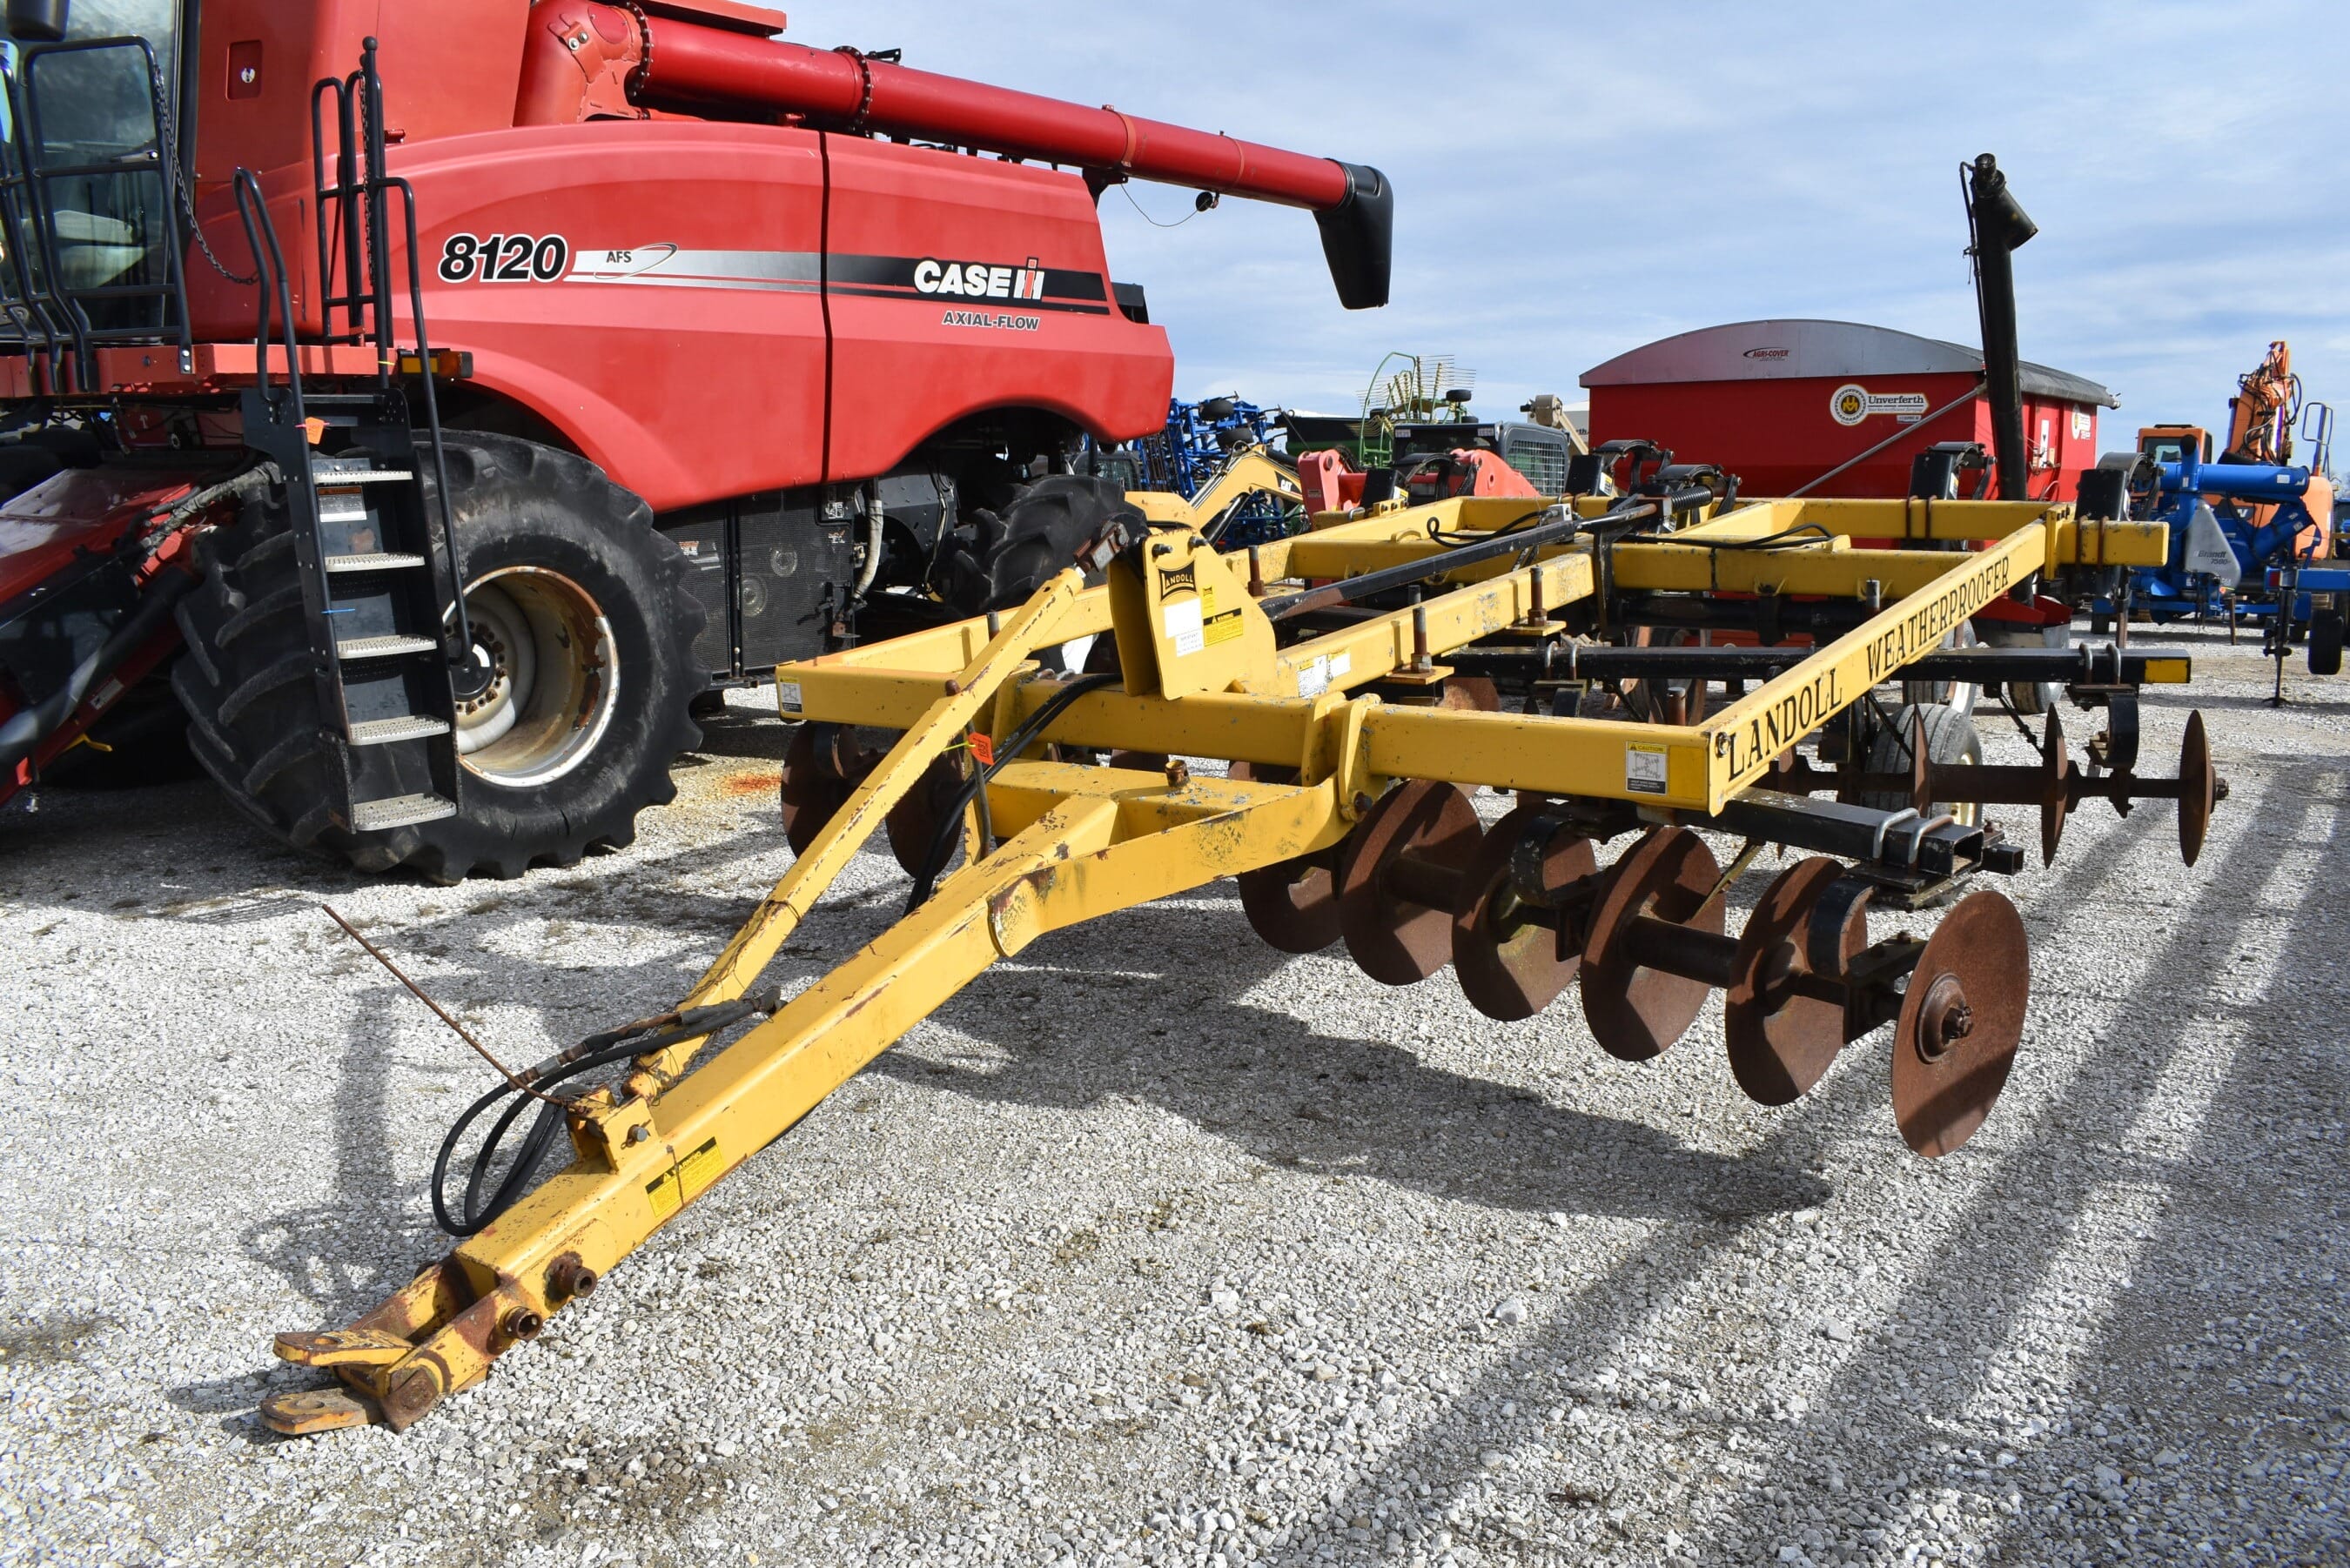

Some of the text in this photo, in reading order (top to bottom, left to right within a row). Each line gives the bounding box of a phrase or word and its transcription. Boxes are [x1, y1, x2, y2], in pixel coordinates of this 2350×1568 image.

[439, 235, 567, 281] 8120
[606, 251, 632, 263] AFS
[914, 260, 1010, 298] CASE
[943, 311, 1039, 330] AXIAL-FLOW
[1868, 395, 1924, 405] Unverferth
[1161, 573, 1193, 596] LANDOLL
[1729, 556, 2009, 781] LANDOLL WEATHERPROOFER
